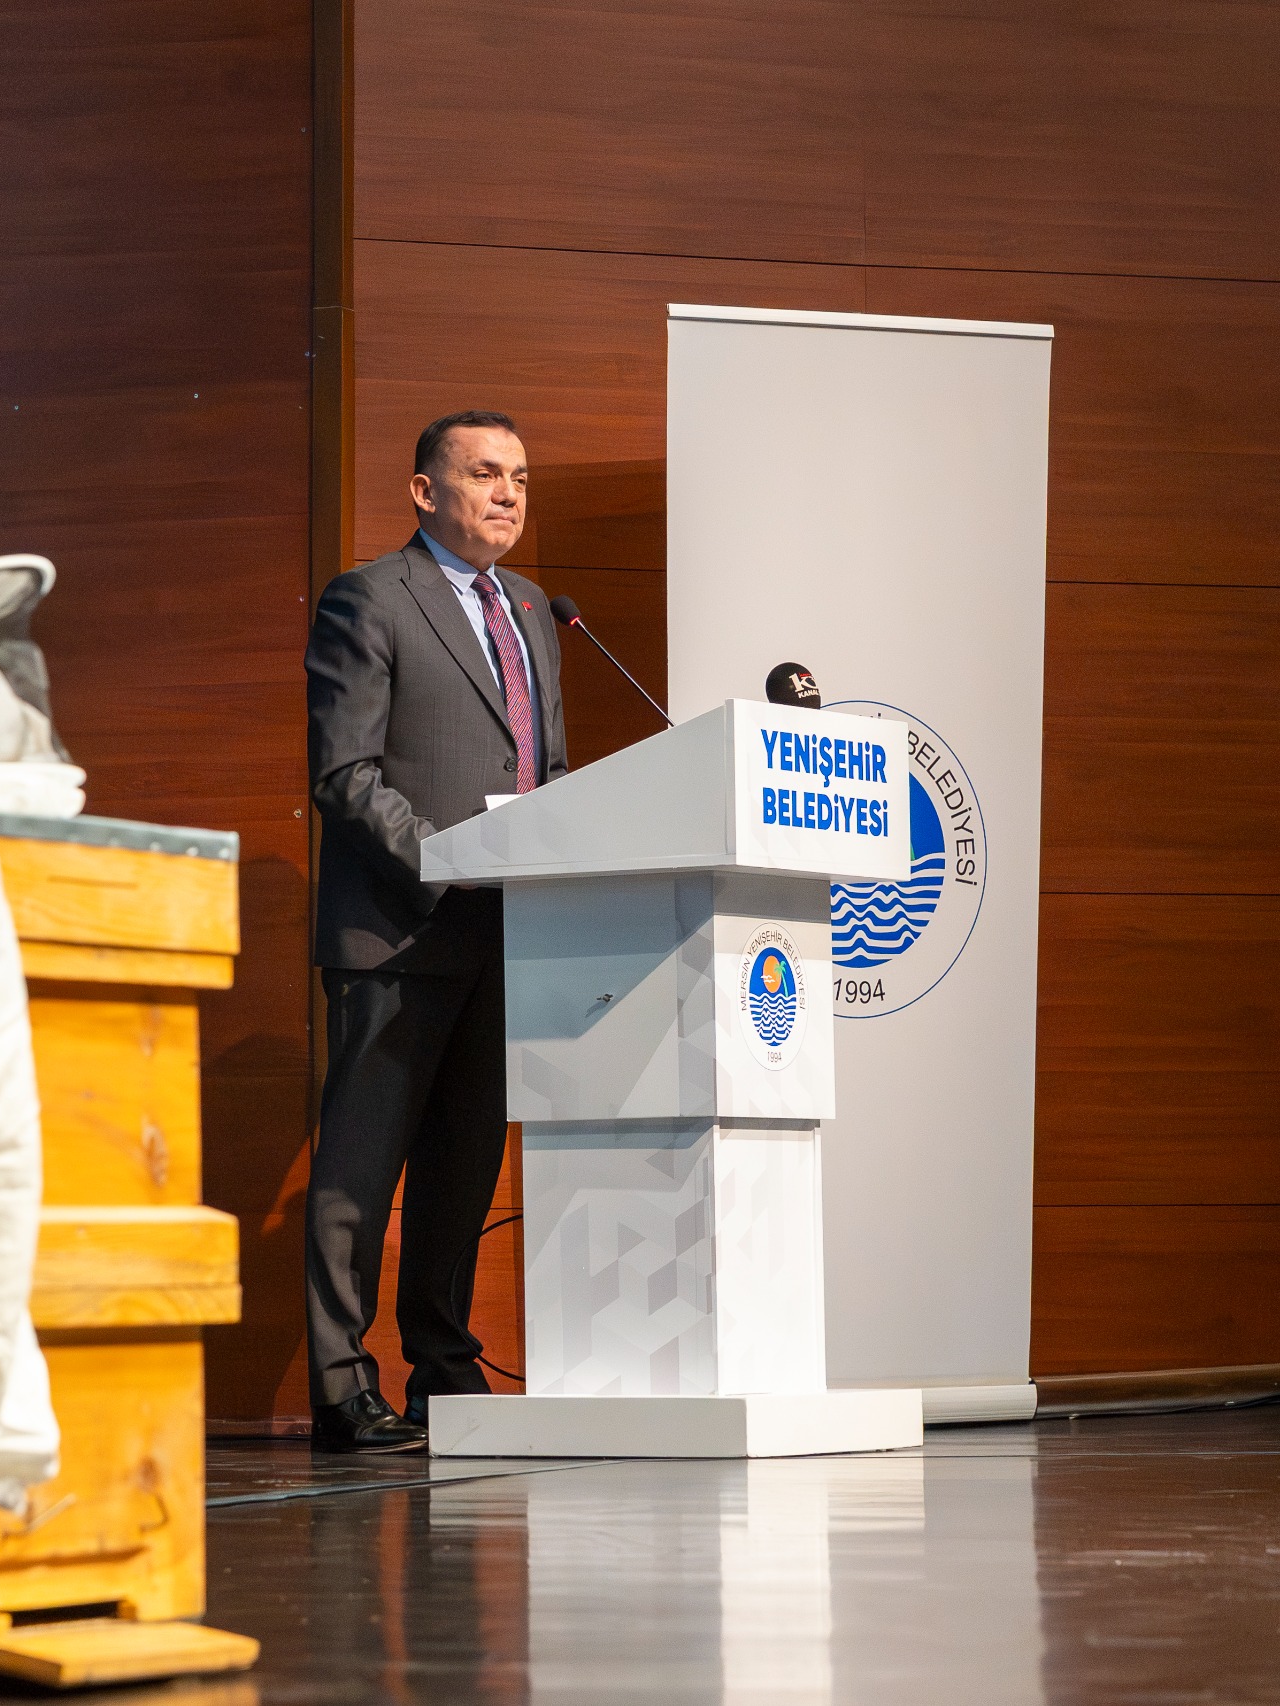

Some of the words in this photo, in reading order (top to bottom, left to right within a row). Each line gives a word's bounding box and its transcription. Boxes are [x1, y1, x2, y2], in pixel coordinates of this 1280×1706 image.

[907, 730, 977, 885] BELEDİYESİ
[740, 958, 751, 1011] MERSİN
[747, 930, 783, 957] YENİŞEHİR
[782, 938, 806, 1010] BELEDİYESİ
[833, 978, 885, 1003] 1994
[767, 1051, 782, 1063] 1994
